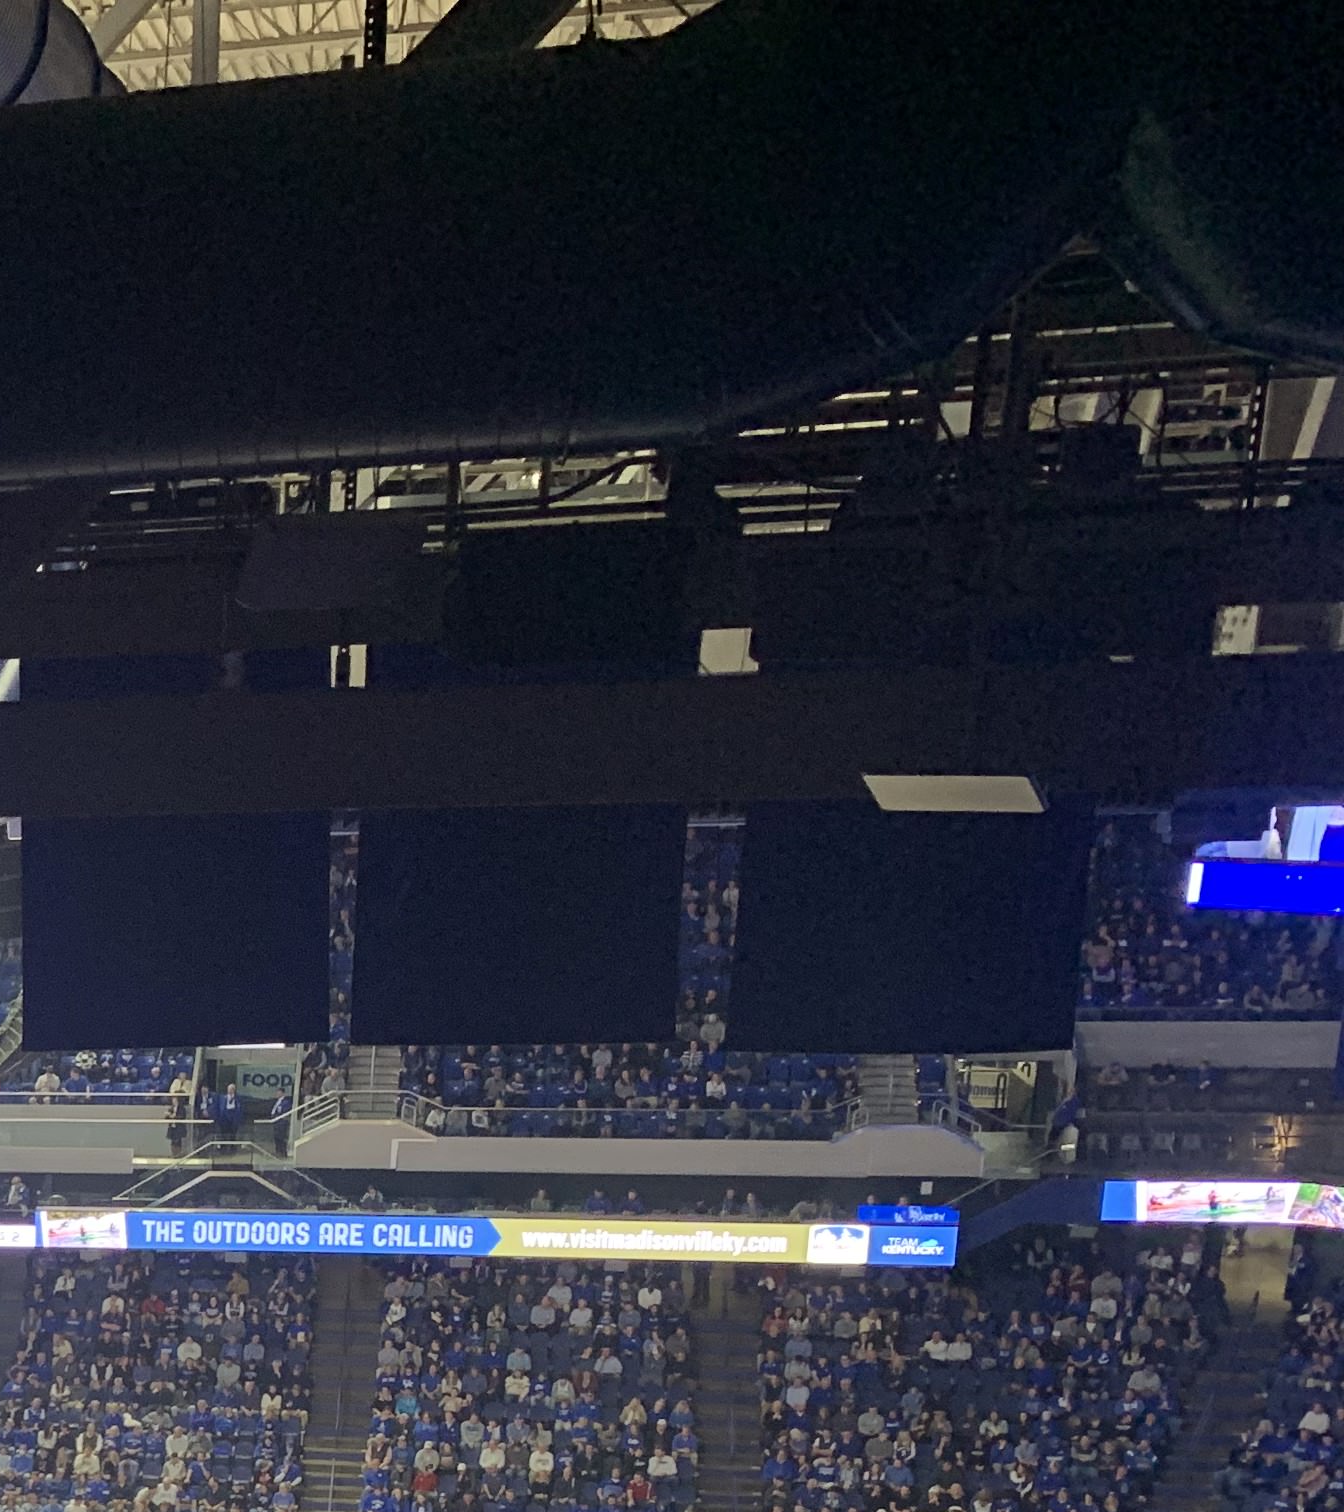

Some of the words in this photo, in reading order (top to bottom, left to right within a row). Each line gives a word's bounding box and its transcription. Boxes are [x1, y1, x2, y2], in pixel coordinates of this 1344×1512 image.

[142, 1219, 185, 1243] THE
[193, 1219, 311, 1246] OUTDOORS
[319, 1223, 364, 1247] ARE
[372, 1223, 474, 1249] CALLING
[521, 1228, 788, 1256] www.visitmadisonvilleky.com
[888, 1237, 919, 1247] TEAM
[882, 1246, 944, 1256] KENTUCKY
